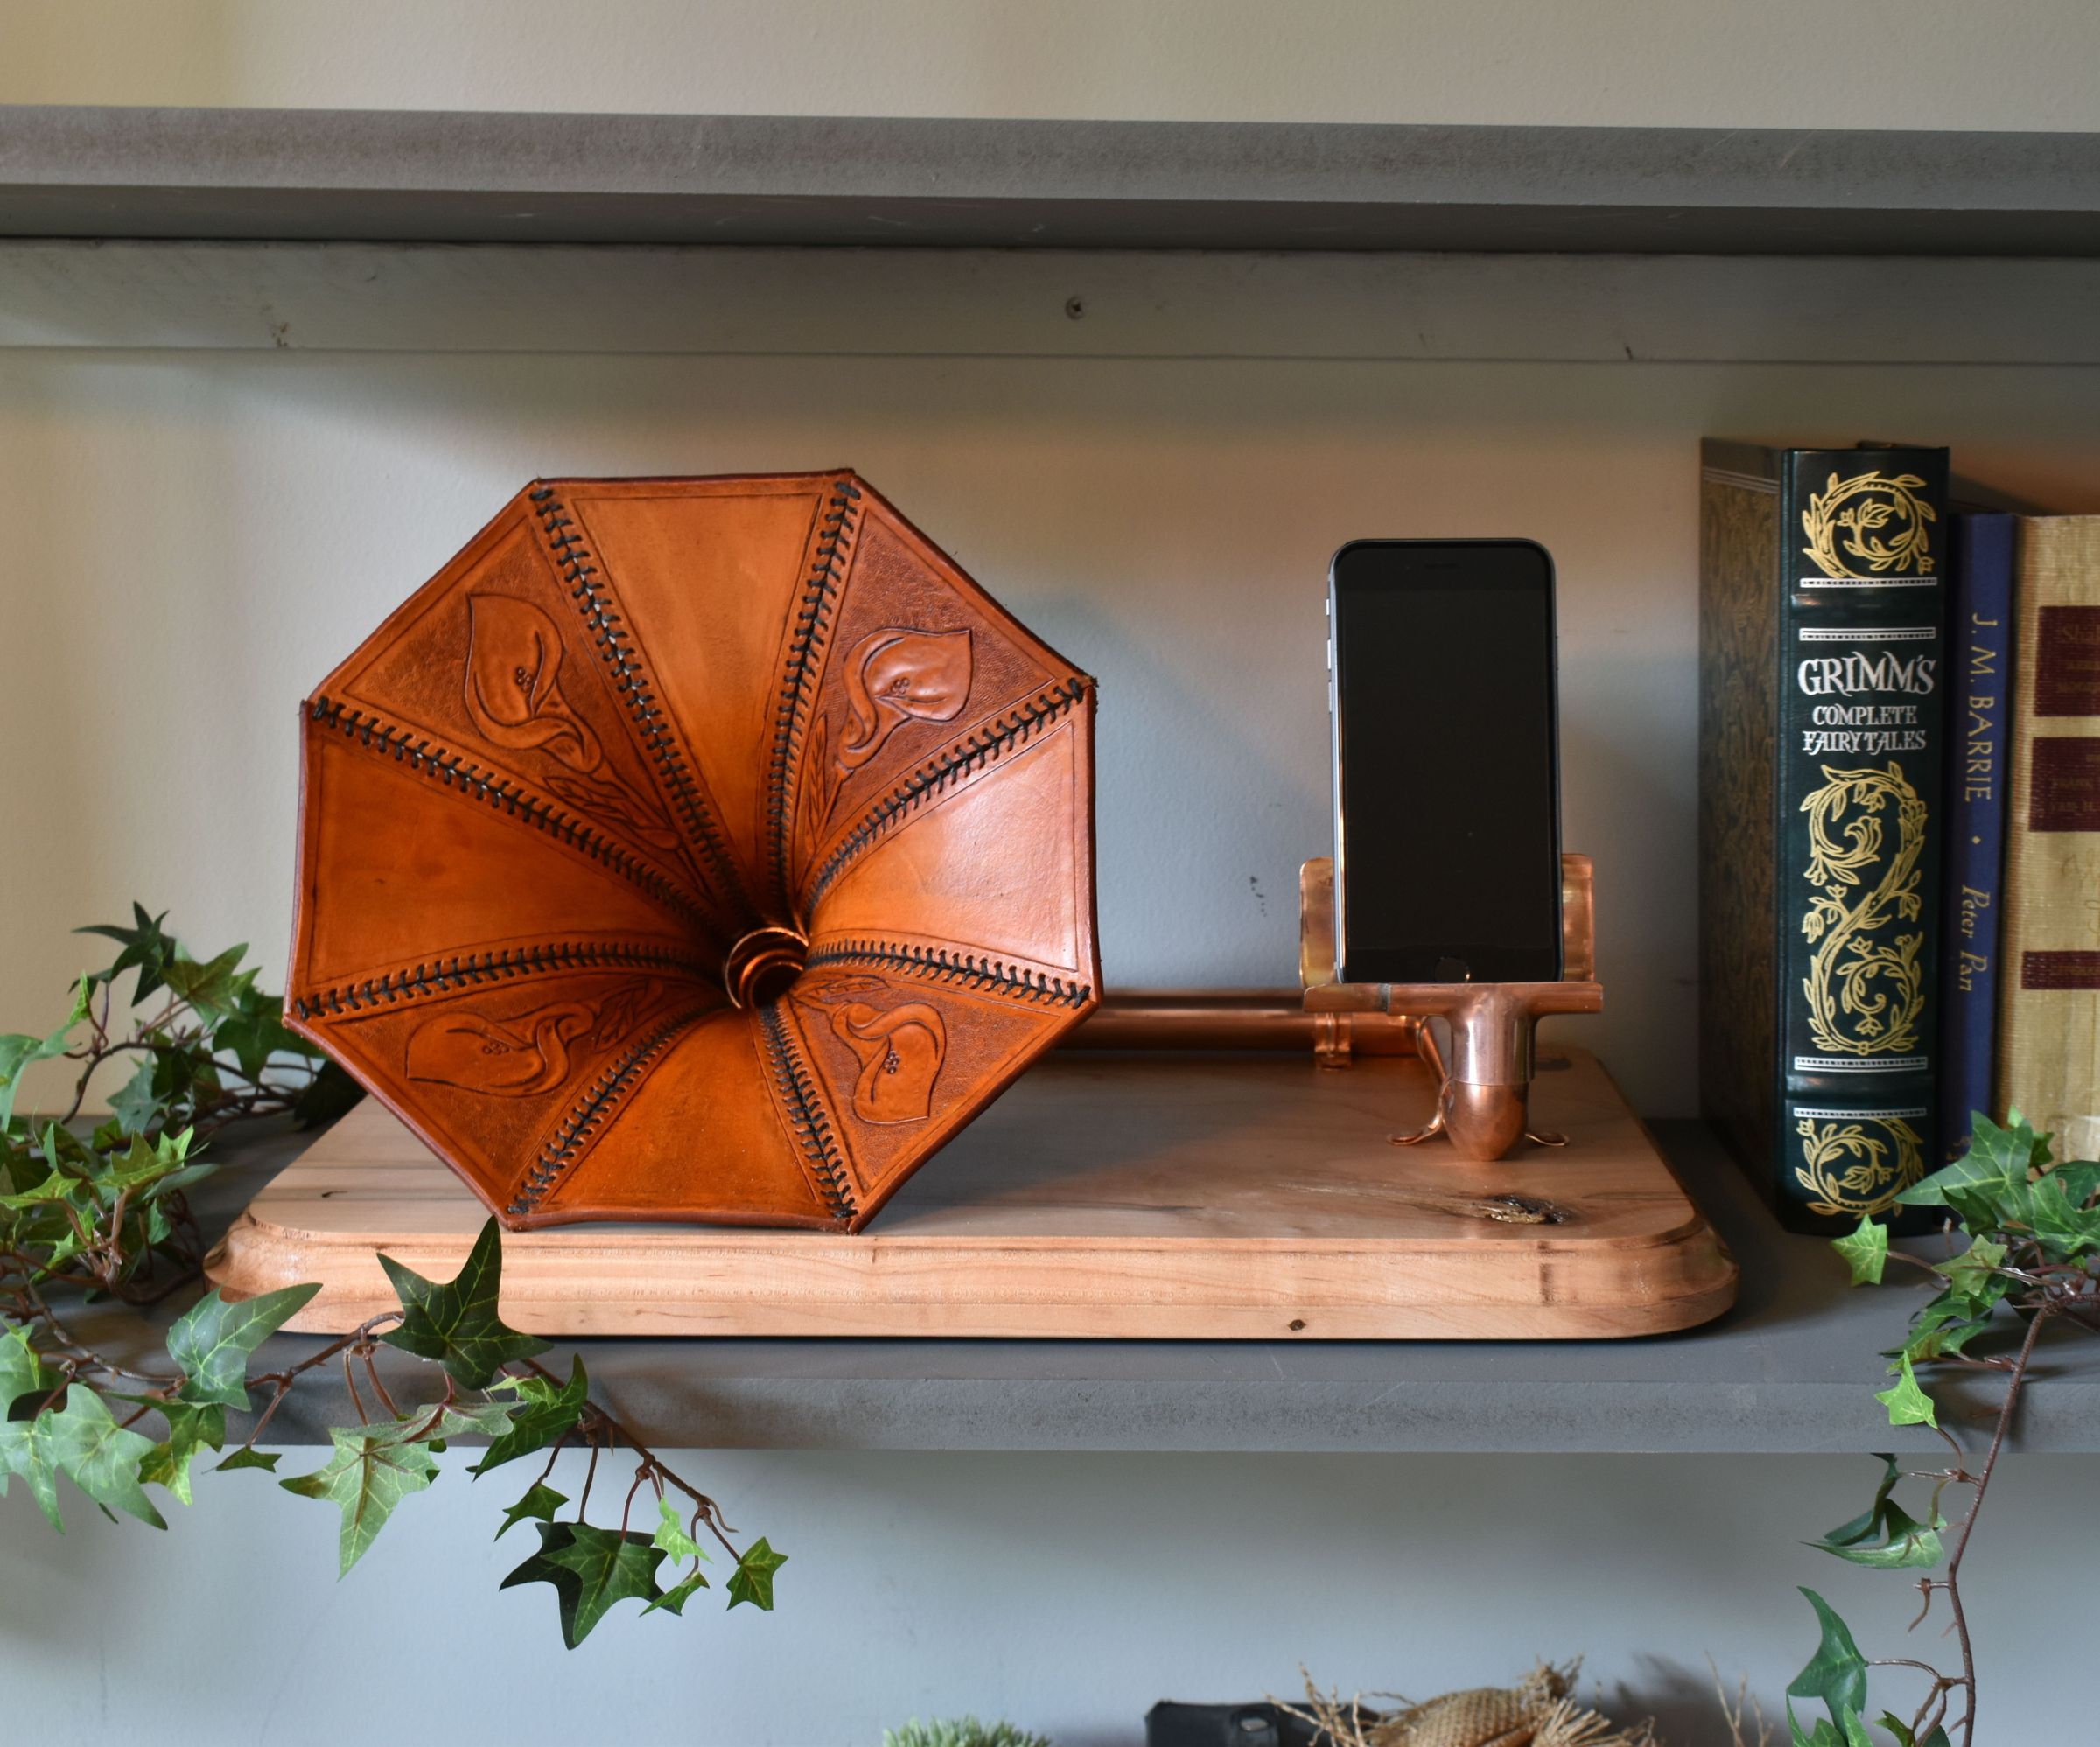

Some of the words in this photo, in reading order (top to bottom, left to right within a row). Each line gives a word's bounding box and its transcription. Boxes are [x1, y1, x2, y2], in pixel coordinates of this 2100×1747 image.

[1971, 612, 1998, 635] J.
[1797, 651, 1936, 697] GRIMM'S
[1969, 645, 1997, 683] M.
[1812, 703, 1918, 726] COMPLETE
[1964, 695, 1995, 803] BARRIE
[1961, 884, 1991, 939] Peter
[1959, 950, 1988, 991] Pan
